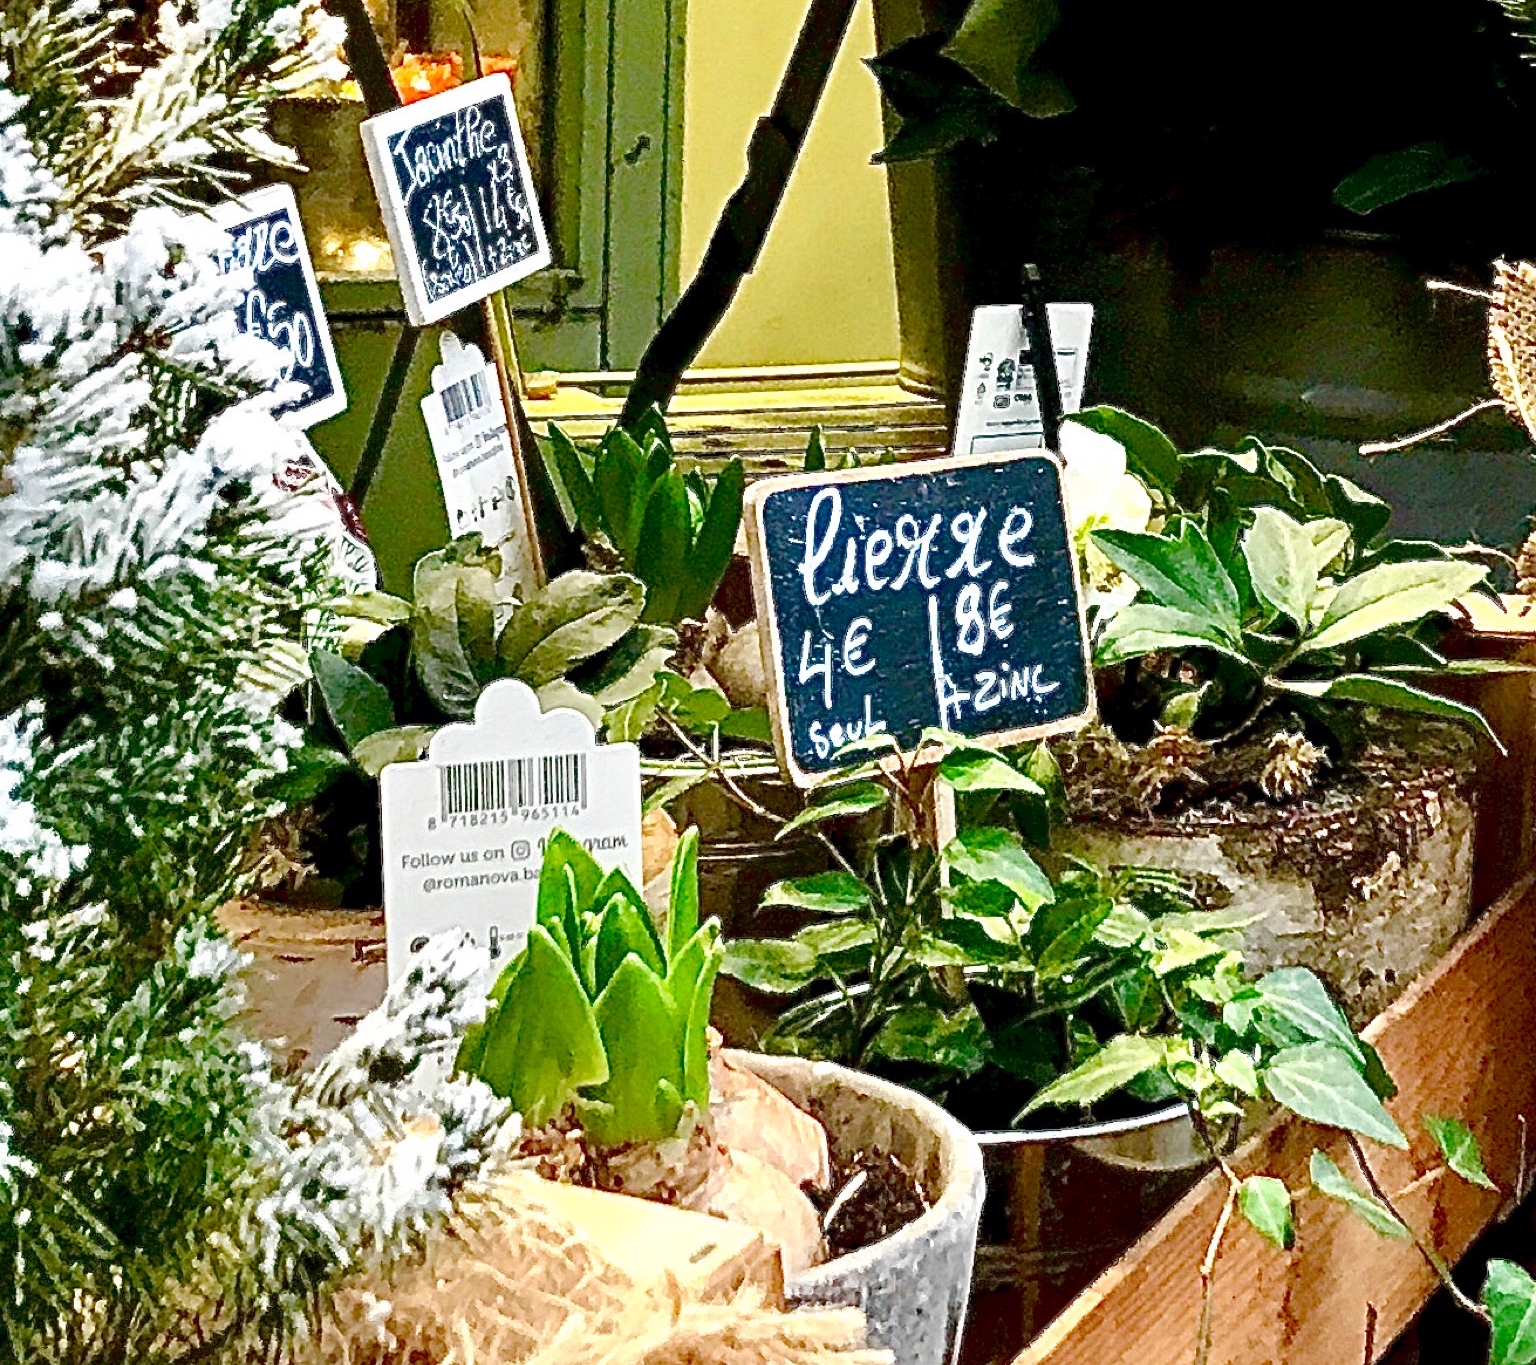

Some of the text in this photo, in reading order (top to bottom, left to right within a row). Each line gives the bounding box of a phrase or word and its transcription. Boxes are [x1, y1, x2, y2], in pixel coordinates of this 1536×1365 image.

[799, 581, 1014, 709] 4€ 8€
[401, 853, 456, 869] Follow
[460, 848, 479, 864] us
[483, 846, 506, 862] on
